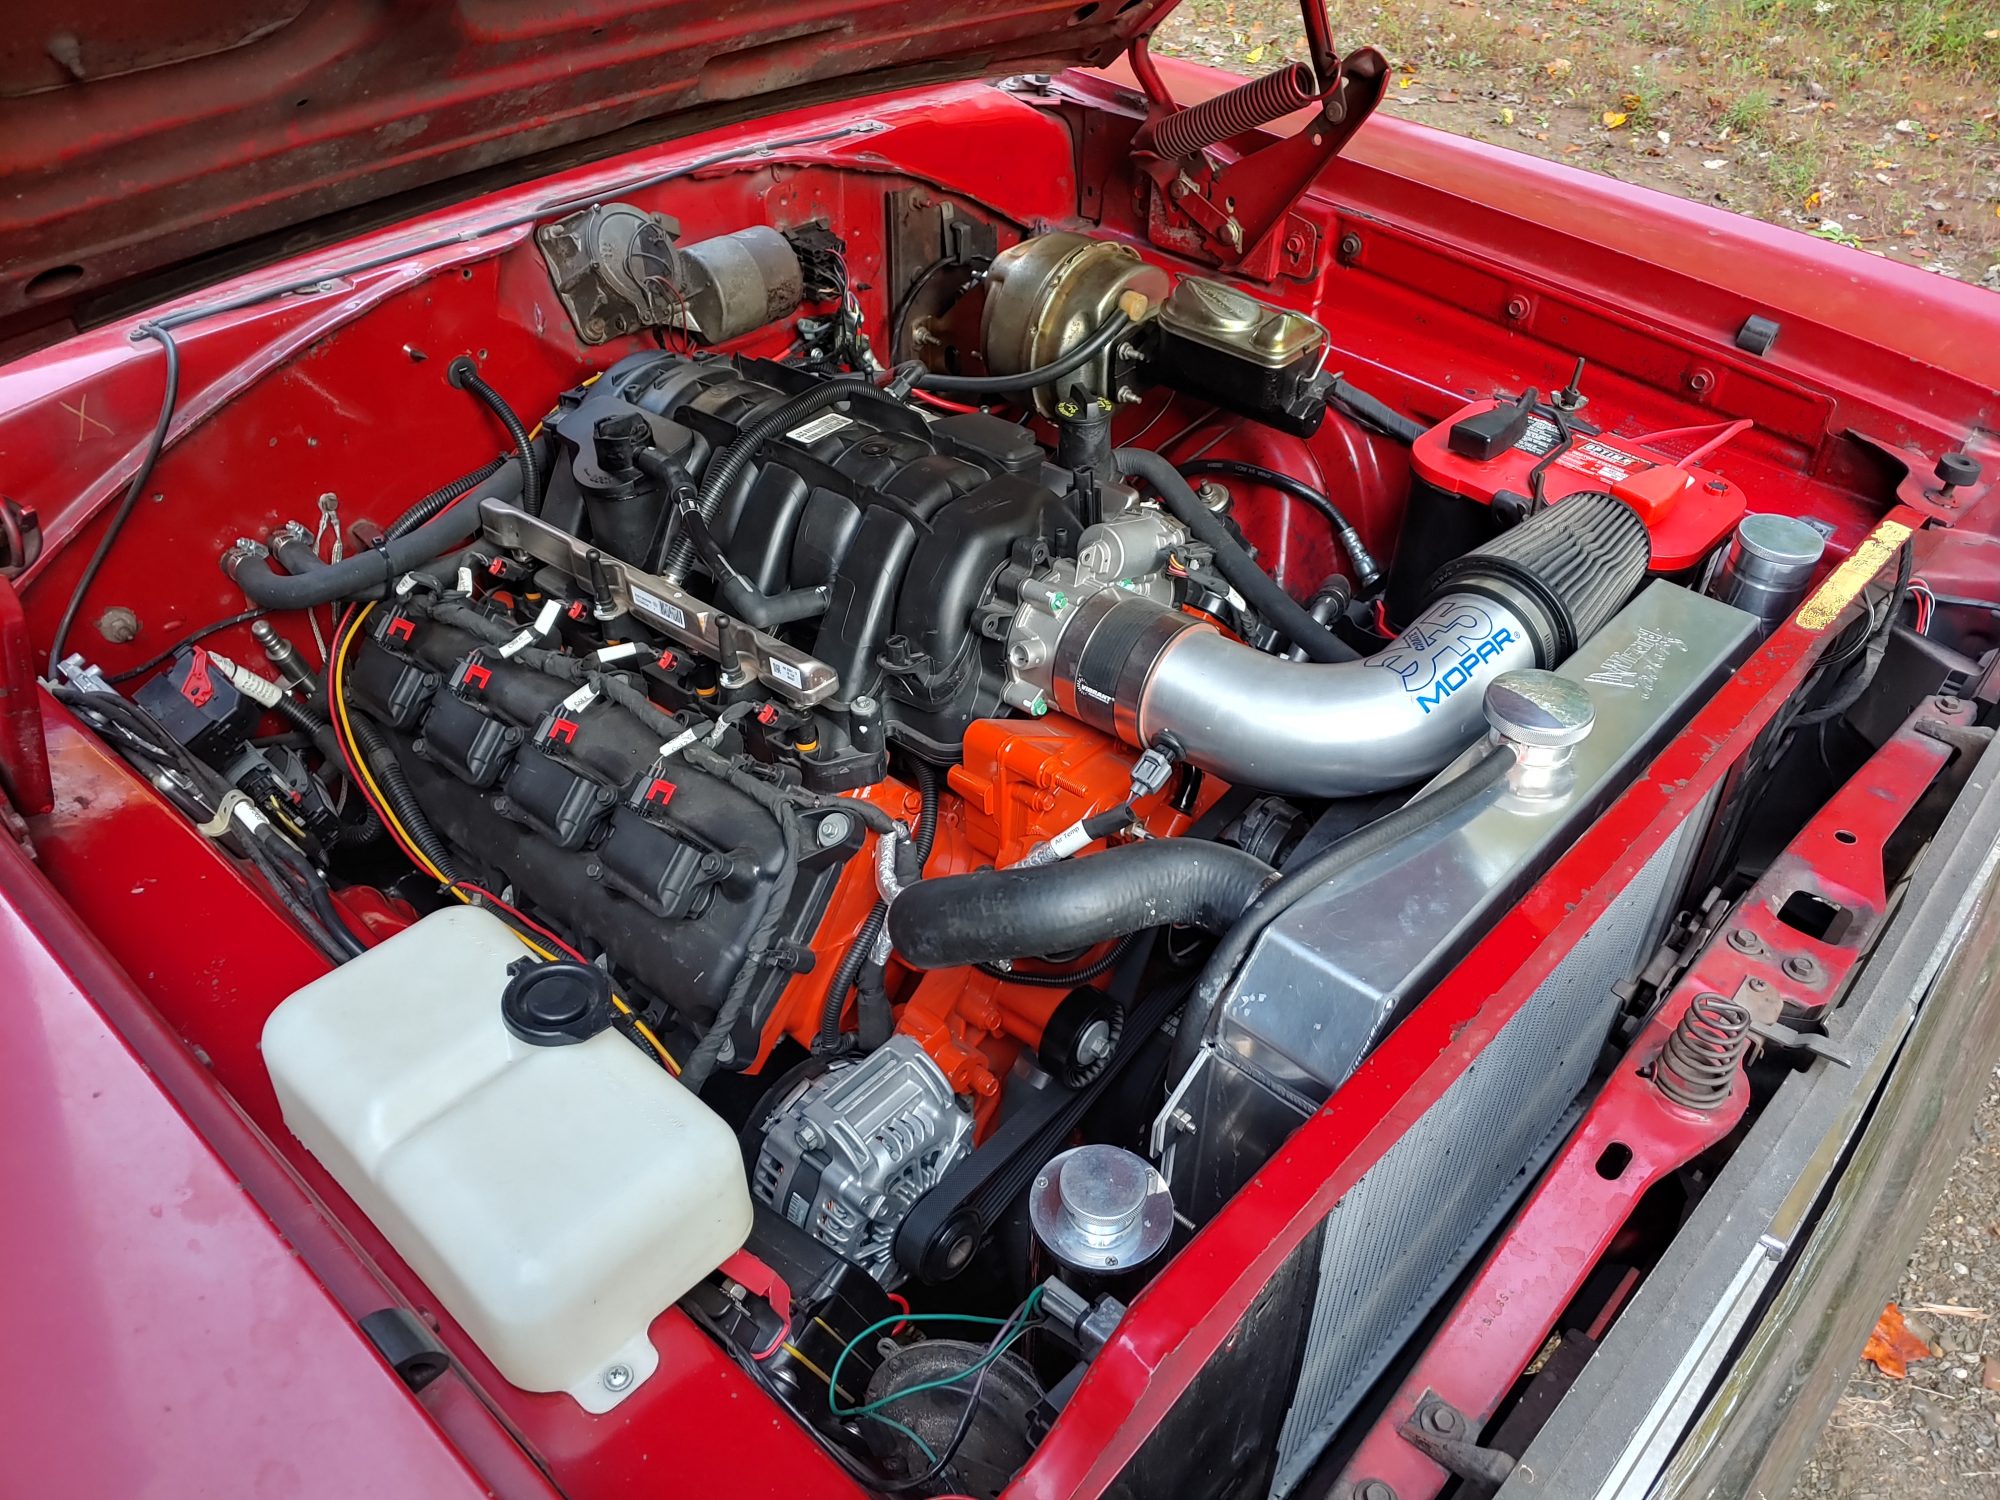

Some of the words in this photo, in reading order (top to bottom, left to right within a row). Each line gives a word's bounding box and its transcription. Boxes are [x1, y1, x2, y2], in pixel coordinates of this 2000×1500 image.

[1364, 602, 1493, 692] 345
[1416, 627, 1516, 714] MOPAR
[1081, 684, 1112, 702] VIBRANT
[1062, 826, 1080, 839] Temp
